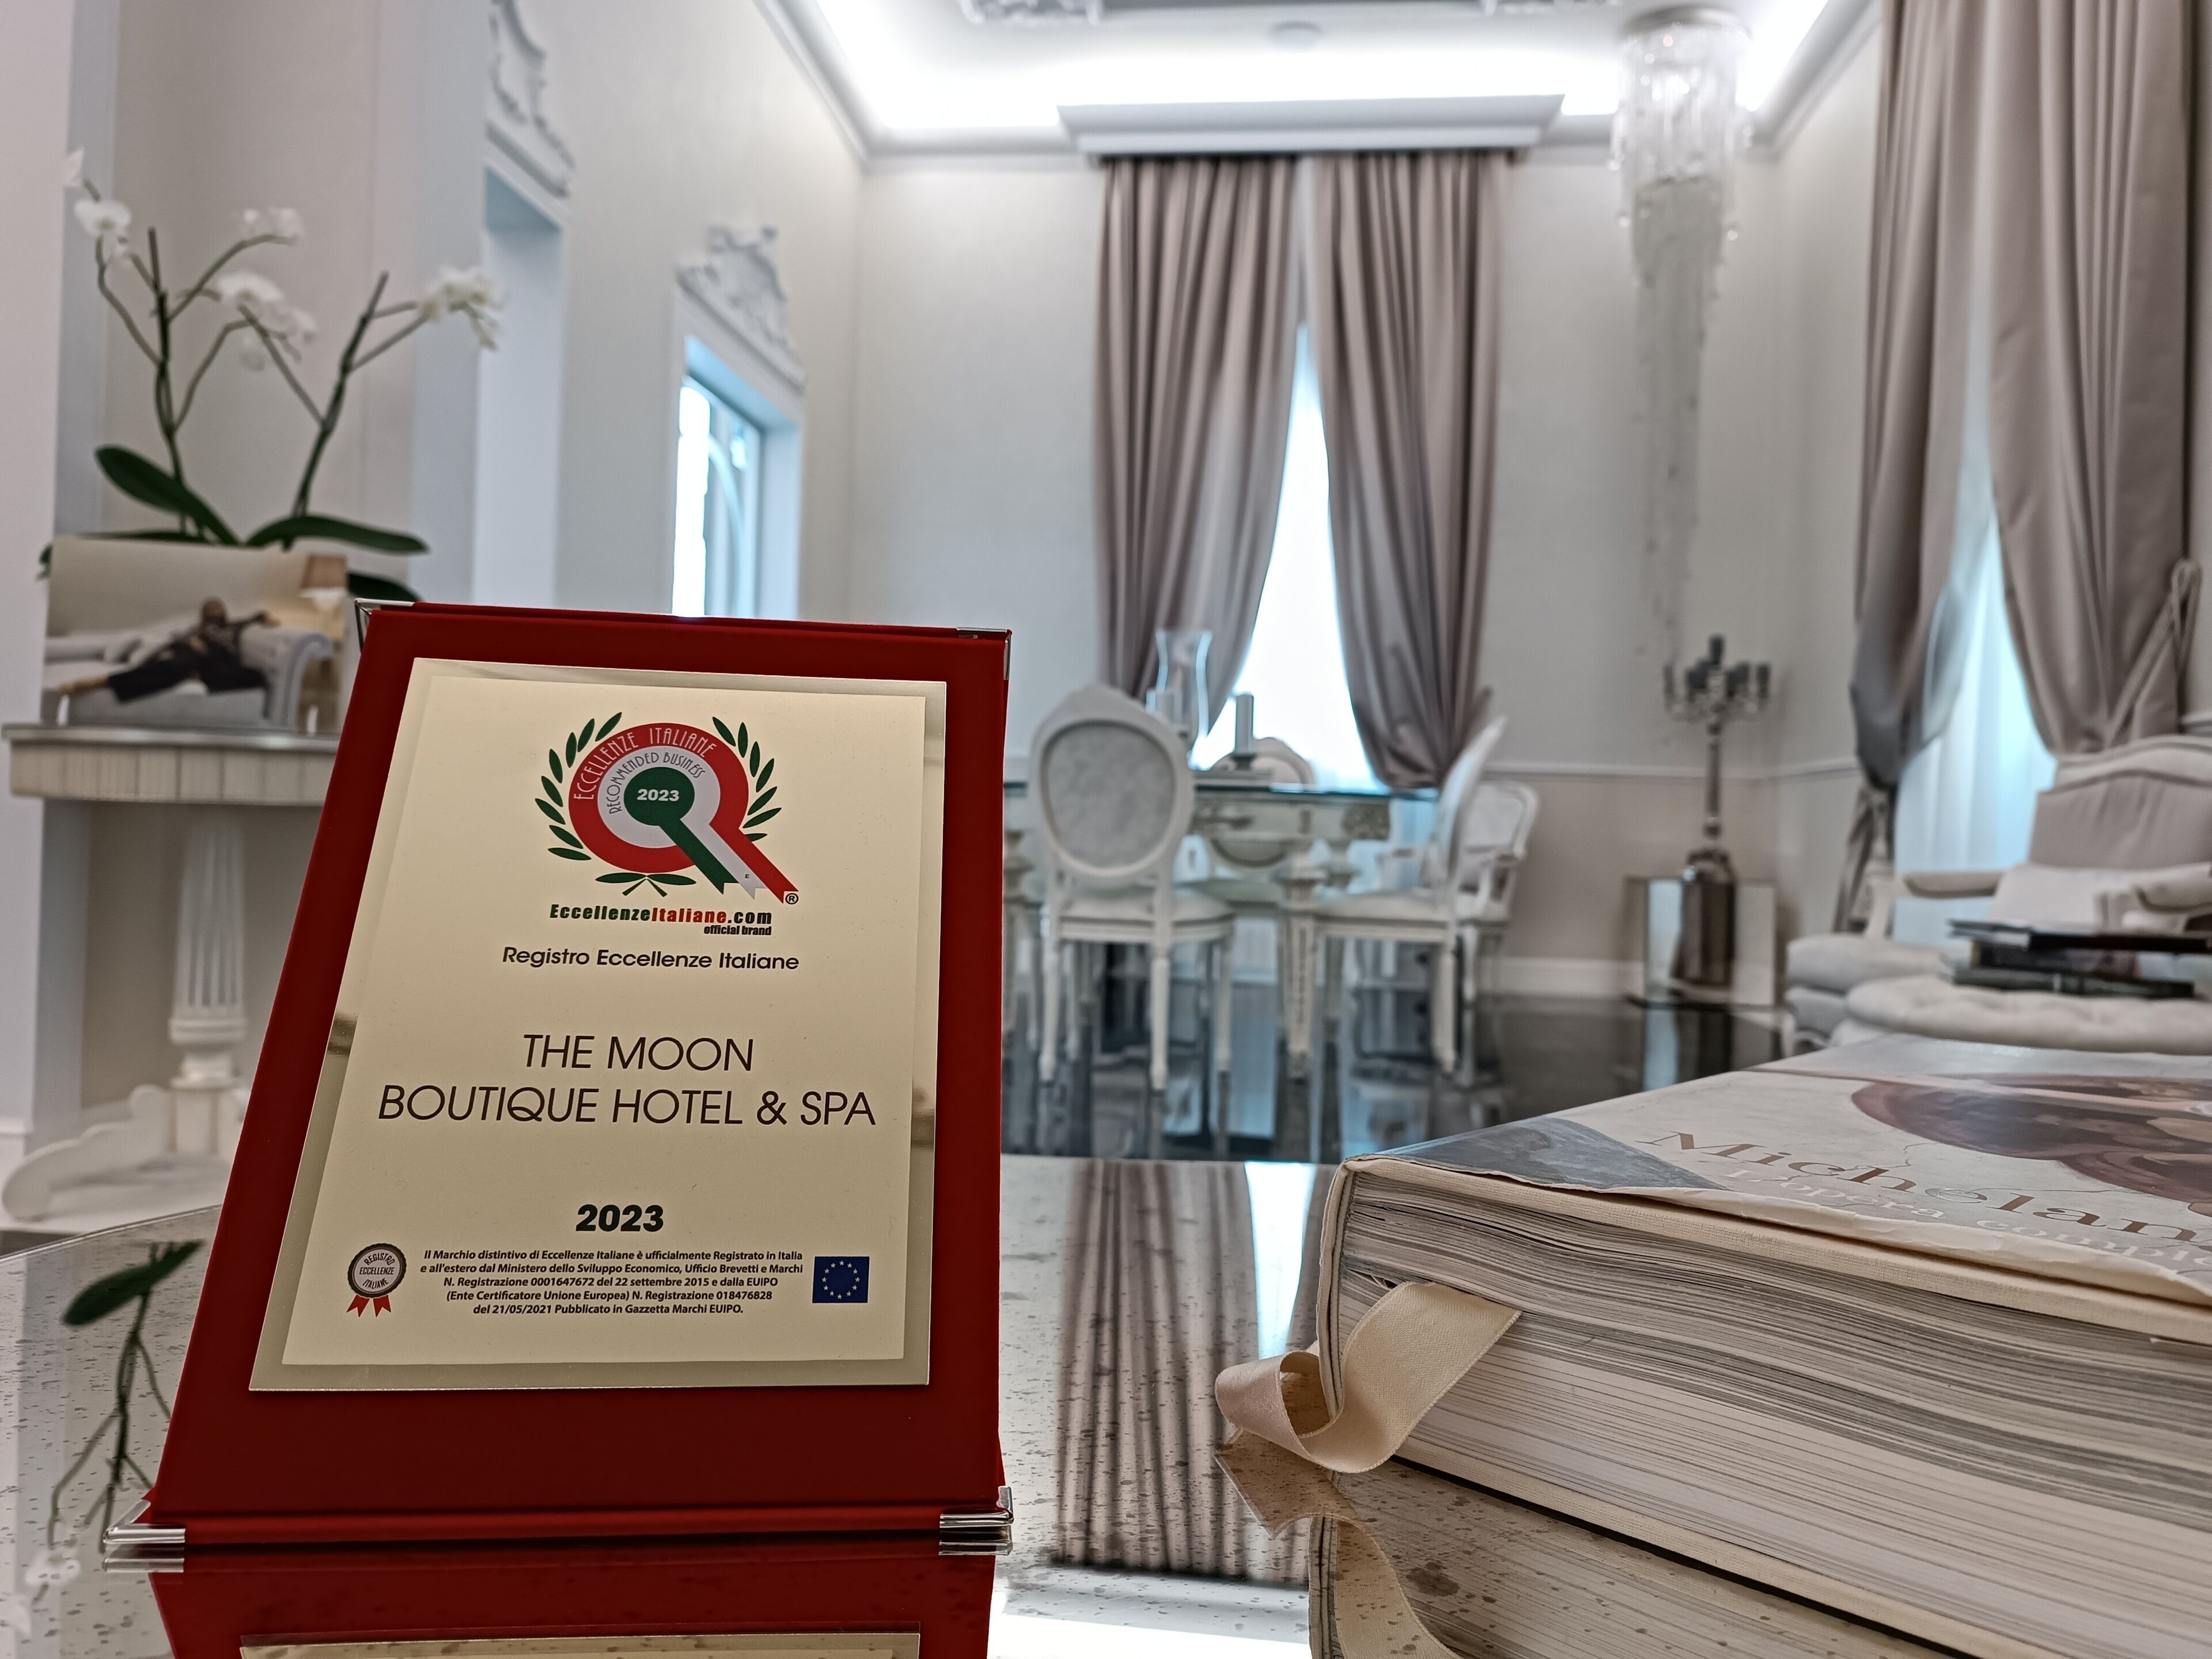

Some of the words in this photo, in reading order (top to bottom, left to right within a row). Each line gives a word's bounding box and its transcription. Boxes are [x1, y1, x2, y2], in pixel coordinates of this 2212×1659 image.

[573, 732, 639, 800] ECCELLENZE
[649, 727, 717, 758] ITALIANE
[606, 752, 660, 815] RECOMMENDED
[662, 752, 706, 779] BUSINESS
[637, 789, 680, 802] 2023
[549, 903, 772, 925] EccellenzeItaliane.com
[703, 925, 740, 935] official
[741, 925, 772, 935] brand
[502, 946, 590, 968] Registro
[596, 949, 713, 968] Eccellenze
[719, 952, 800, 970] Italiane
[523, 1034, 595, 1069] THE
[607, 1036, 753, 1071] MOON
[378, 1085, 599, 1122] BOUTIQUE
[612, 1089, 743, 1124] HOTEL
[756, 1090, 787, 1125] &
[800, 1091, 876, 1126] SPA
[575, 1204, 664, 1232] 2023
[363, 1252, 396, 1266] REGISTRO
[424, 1249, 431, 1259] Il
[433, 1249, 476, 1259] Marchio
[478, 1249, 527, 1259] distintivo
[529, 1250, 540, 1259] di
[541, 1250, 594, 1260] Eccellenze
[596, 1250, 635, 1260] Italiane
[637, 1251, 643, 1260] è
[645, 1250, 711, 1260] ufficialmente
[713, 1251, 764, 1262] Registrato
[766, 1251, 776, 1260] in
[778, 1251, 802, 1260] Italia
[359, 1267, 395, 1275] ECCELLENZE
[429, 1263, 477, 1273] all'estero
[479, 1263, 496, 1273] dal
[497, 1263, 547, 1273] Ministero
[549, 1263, 575, 1273] dello
[577, 1263, 623, 1275] Sviluppo
[624, 1264, 683, 1274] Economico,
[685, 1263, 717, 1273] Ufficio
[719, 1264, 759, 1273] Brevetti
[769, 1264, 803, 1273] Marchi
[362, 1277, 389, 1289] ITALIANE
[444, 1277, 454, 1286] N.
[457, 1277, 529, 1289] Registrazione
[531, 1277, 594, 1286] 0001647672
[596, 1277, 613, 1286] del
[615, 1277, 628, 1286] 22
[630, 1277, 683, 1286] settembre
[684, 1277, 710, 1286] 2015
[719, 1277, 744, 1286] dalla
[747, 1277, 778, 1286] EUIPO
[446, 1290, 475, 1302] (Ente
[476, 1290, 541, 1300] Certificatore
[544, 1290, 581, 1300] Unione
[583, 1290, 630, 1302] Europea)
[632, 1290, 643, 1300] N.
[645, 1290, 714, 1302] Registrazione
[716, 1291, 772, 1300] 018476828
[473, 1304, 491, 1314] del
[491, 1304, 551, 1315] 21/05/2021
[554, 1304, 611, 1314] Pubblicato
[612, 1304, 623, 1313] in
[624, 1304, 670, 1314] Gazzetta
[672, 1304, 707, 1313] Marchi
[709, 1304, 743, 1313] EUIPO.
